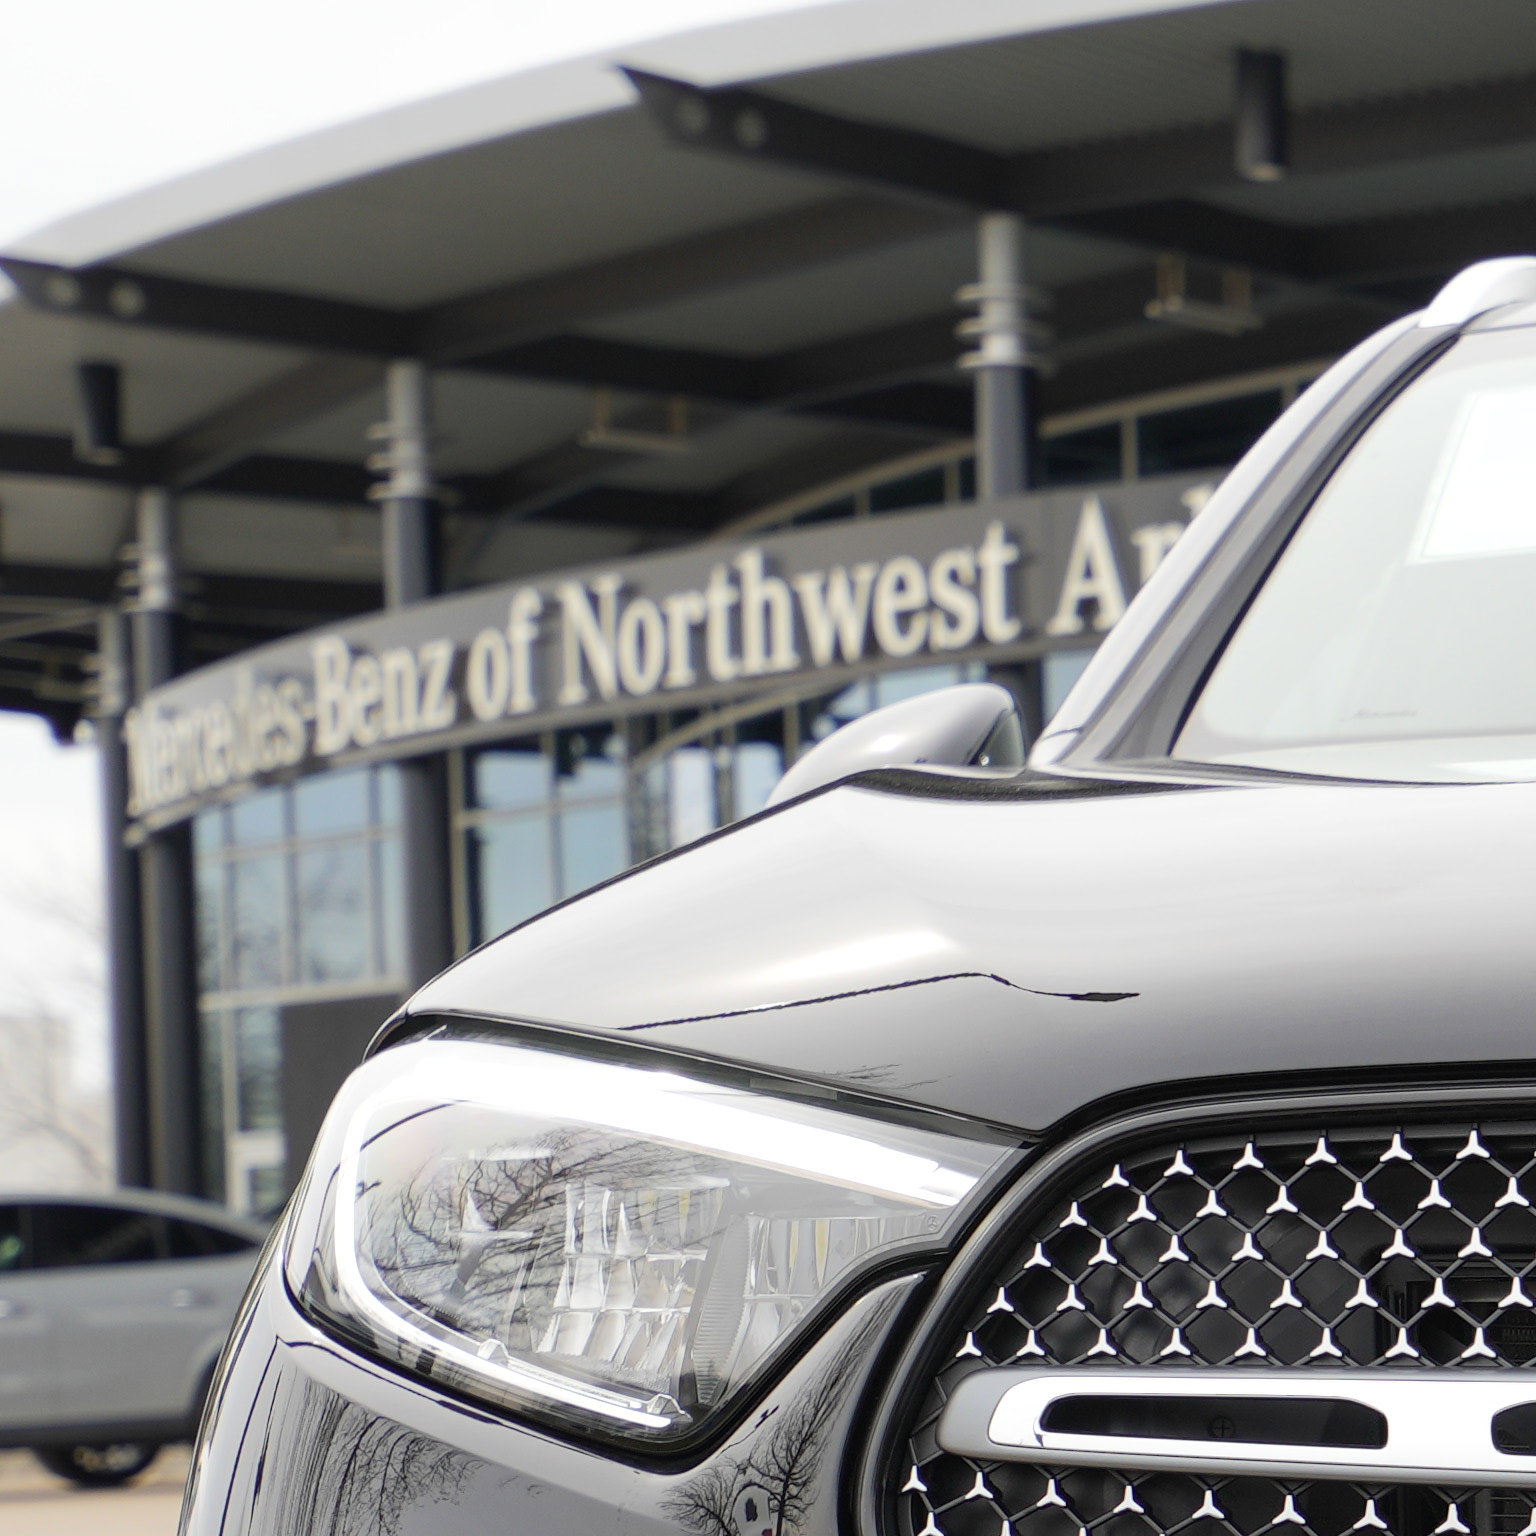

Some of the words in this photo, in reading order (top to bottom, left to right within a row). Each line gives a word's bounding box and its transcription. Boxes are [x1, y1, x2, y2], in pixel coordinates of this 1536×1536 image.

[123, 634, 458, 818] Mercedes-Benz
[466, 586, 543, 723] of
[555, 519, 1022, 706] Northwest
